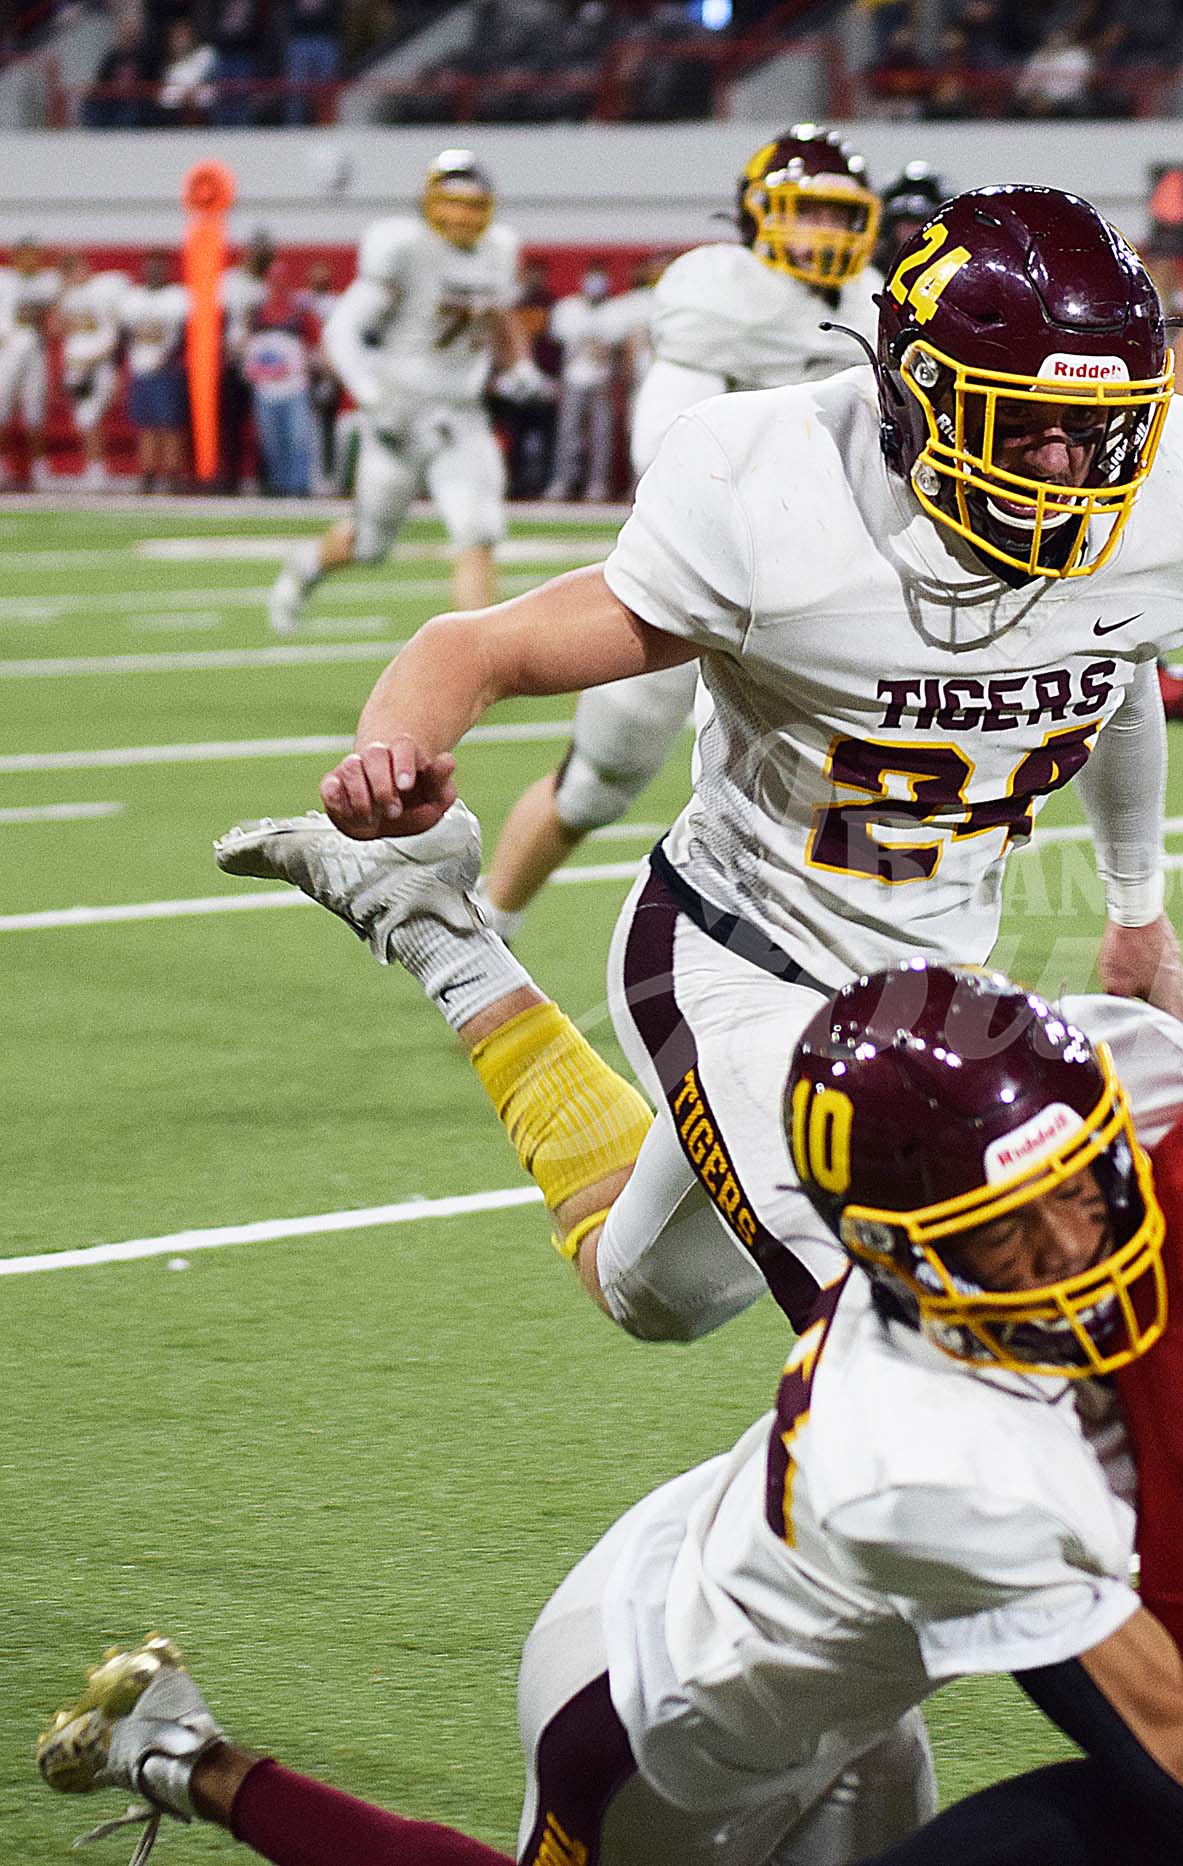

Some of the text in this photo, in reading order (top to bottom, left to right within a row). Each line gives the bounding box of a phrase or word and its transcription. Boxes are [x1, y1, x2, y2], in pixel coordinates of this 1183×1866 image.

[890, 223, 972, 325] 24
[876, 659, 1118, 732] TIGERS
[805, 718, 1104, 886] 24
[674, 1068, 758, 1247] TIGERS
[792, 1078, 854, 1195] 10
